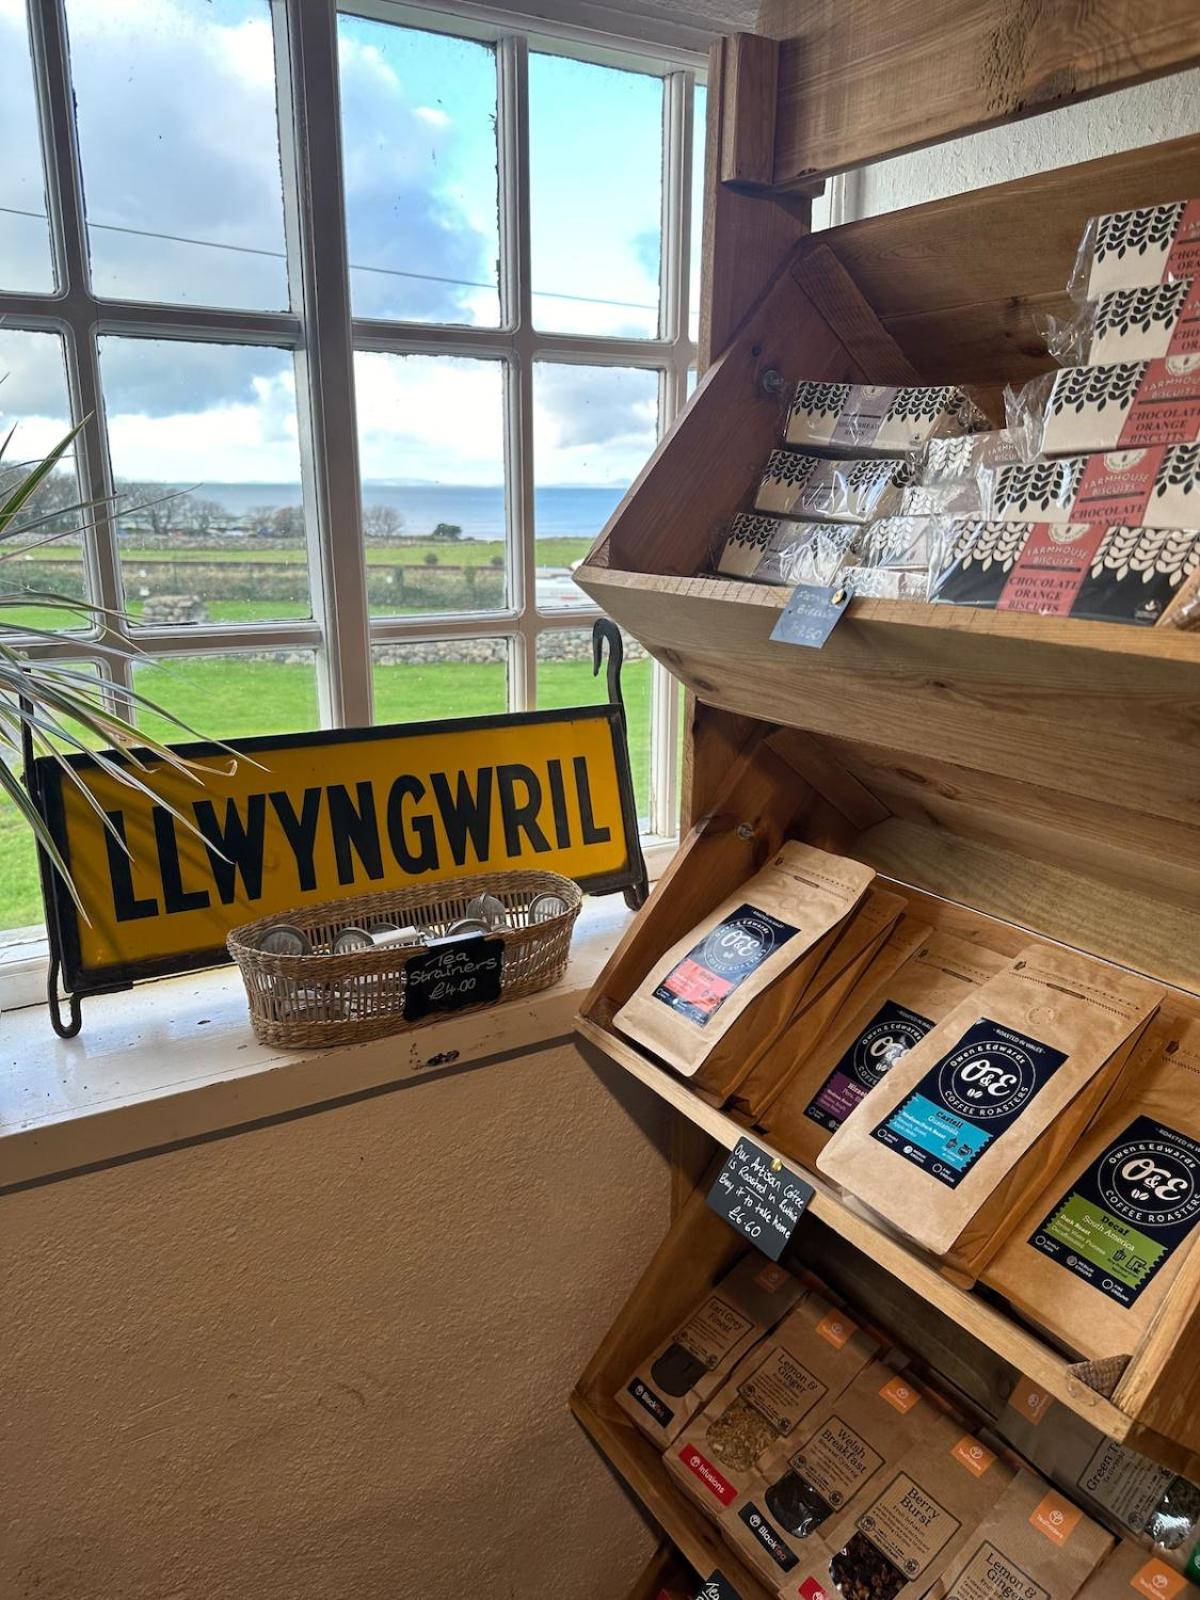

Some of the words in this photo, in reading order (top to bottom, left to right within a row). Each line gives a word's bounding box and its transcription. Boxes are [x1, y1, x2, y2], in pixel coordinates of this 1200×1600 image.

[1143, 375, 1200, 391] FARMHOU
[1129, 407, 1200, 421] CHOCOLATE
[1136, 419, 1187, 432] ORANGE
[1130, 431, 1185, 443] BISCUITS
[1084, 473, 1150, 489] FARMHOUSE
[1092, 483, 1136, 496] BISCUITS
[1071, 503, 1146, 520] CHOCOLATE
[1027, 545, 1088, 559] FARMHOUSE
[1033, 556, 1075, 566] BISCUITS
[1009, 576, 1079, 590] CHOCOLATE
[1015, 588, 1062, 601] ORANGE
[1008, 600, 1059, 613] BISCUITS
[104, 756, 611, 922] LLWYNGWRIL
[424, 949, 469, 967] Tea
[410, 958, 497, 986] Strainers
[429, 978, 476, 1000] £4.00
[950, 1049, 975, 1067] Owen
[986, 1044, 1026, 1064] Edwards
[858, 1066, 878, 1086] COFFE
[961, 1060, 1017, 1096] O&E
[945, 1090, 975, 1115] COFFEE
[980, 1086, 1029, 1116] ROASTERS
[936, 1111, 964, 1128] Castell
[1158, 1128, 1187, 1146] ROASTED
[1109, 1146, 1136, 1164] Owen
[1149, 1143, 1196, 1168] Edwards
[734, 1144, 750, 1163] Our
[751, 1157, 781, 1192] Artisan
[783, 1184, 804, 1209] Coffee
[738, 1165, 768, 1194] Roasted
[1121, 1158, 1188, 1200] O&E
[719, 1172, 735, 1195] Buy
[736, 1186, 745, 1197] it
[744, 1194, 753, 1207] to
[755, 1202, 772, 1223] take
[772, 1214, 791, 1239] home
[1106, 1189, 1142, 1219] COFFEE
[1148, 1193, 1200, 1223] ROASTERS
[728, 1206, 761, 1237] £6.60
[1082, 1214, 1104, 1232] South
[1104, 1229, 1136, 1252] America
[1101, 1215, 1130, 1236] Decaf
[777, 1354, 808, 1385] Lemon
[821, 1429, 867, 1475] Breakfast
[837, 1428, 867, 1460] Welsh
[698, 1463, 725, 1495] Infusions
[1086, 1456, 1113, 1491] Green
[900, 1495, 932, 1527] Burst
[907, 1487, 941, 1520] Berry
[985, 1552, 1024, 1590] Lemon
[1024, 1586, 1037, 1598] &
